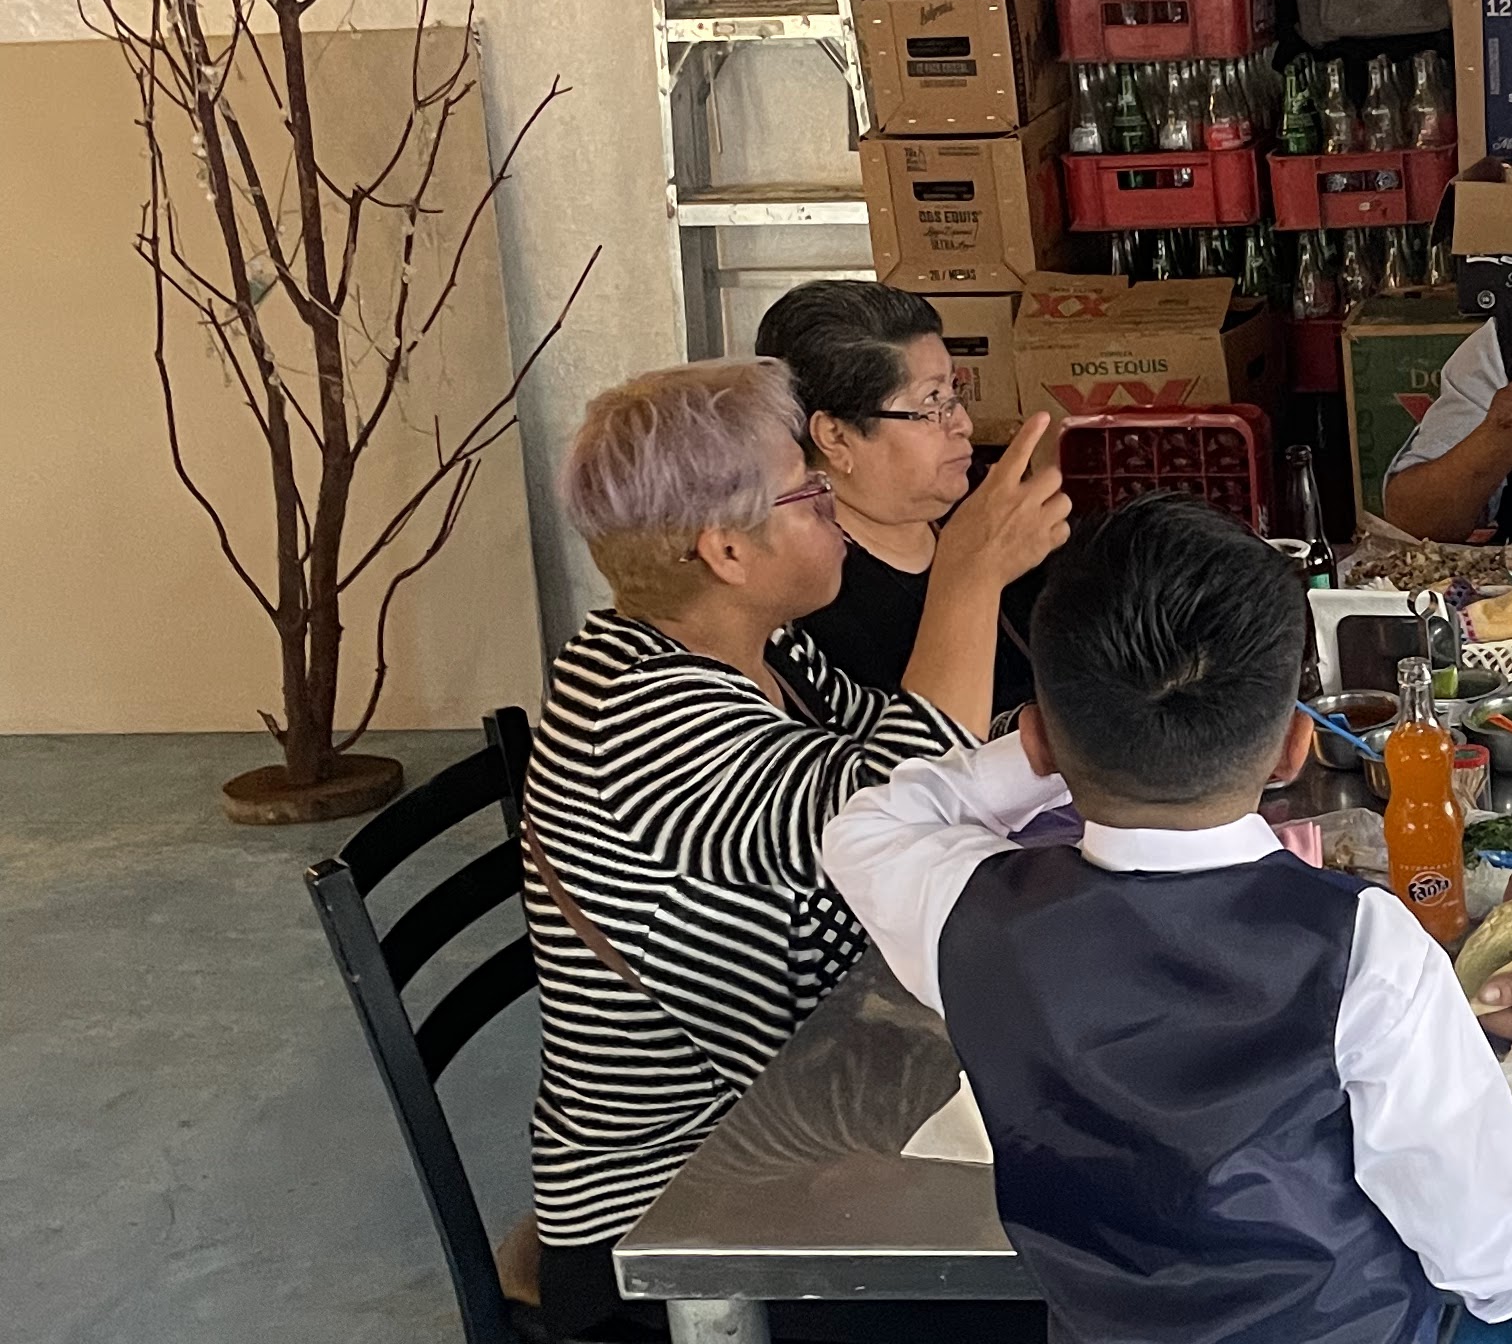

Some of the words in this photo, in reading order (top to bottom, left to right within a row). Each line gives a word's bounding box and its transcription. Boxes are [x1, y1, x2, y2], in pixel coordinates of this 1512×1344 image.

[1071, 361, 1109, 377] DOS
[1114, 358, 1169, 377] EQUIS
[1410, 368, 1442, 388] DO
[1407, 878, 1450, 903] Fanta
